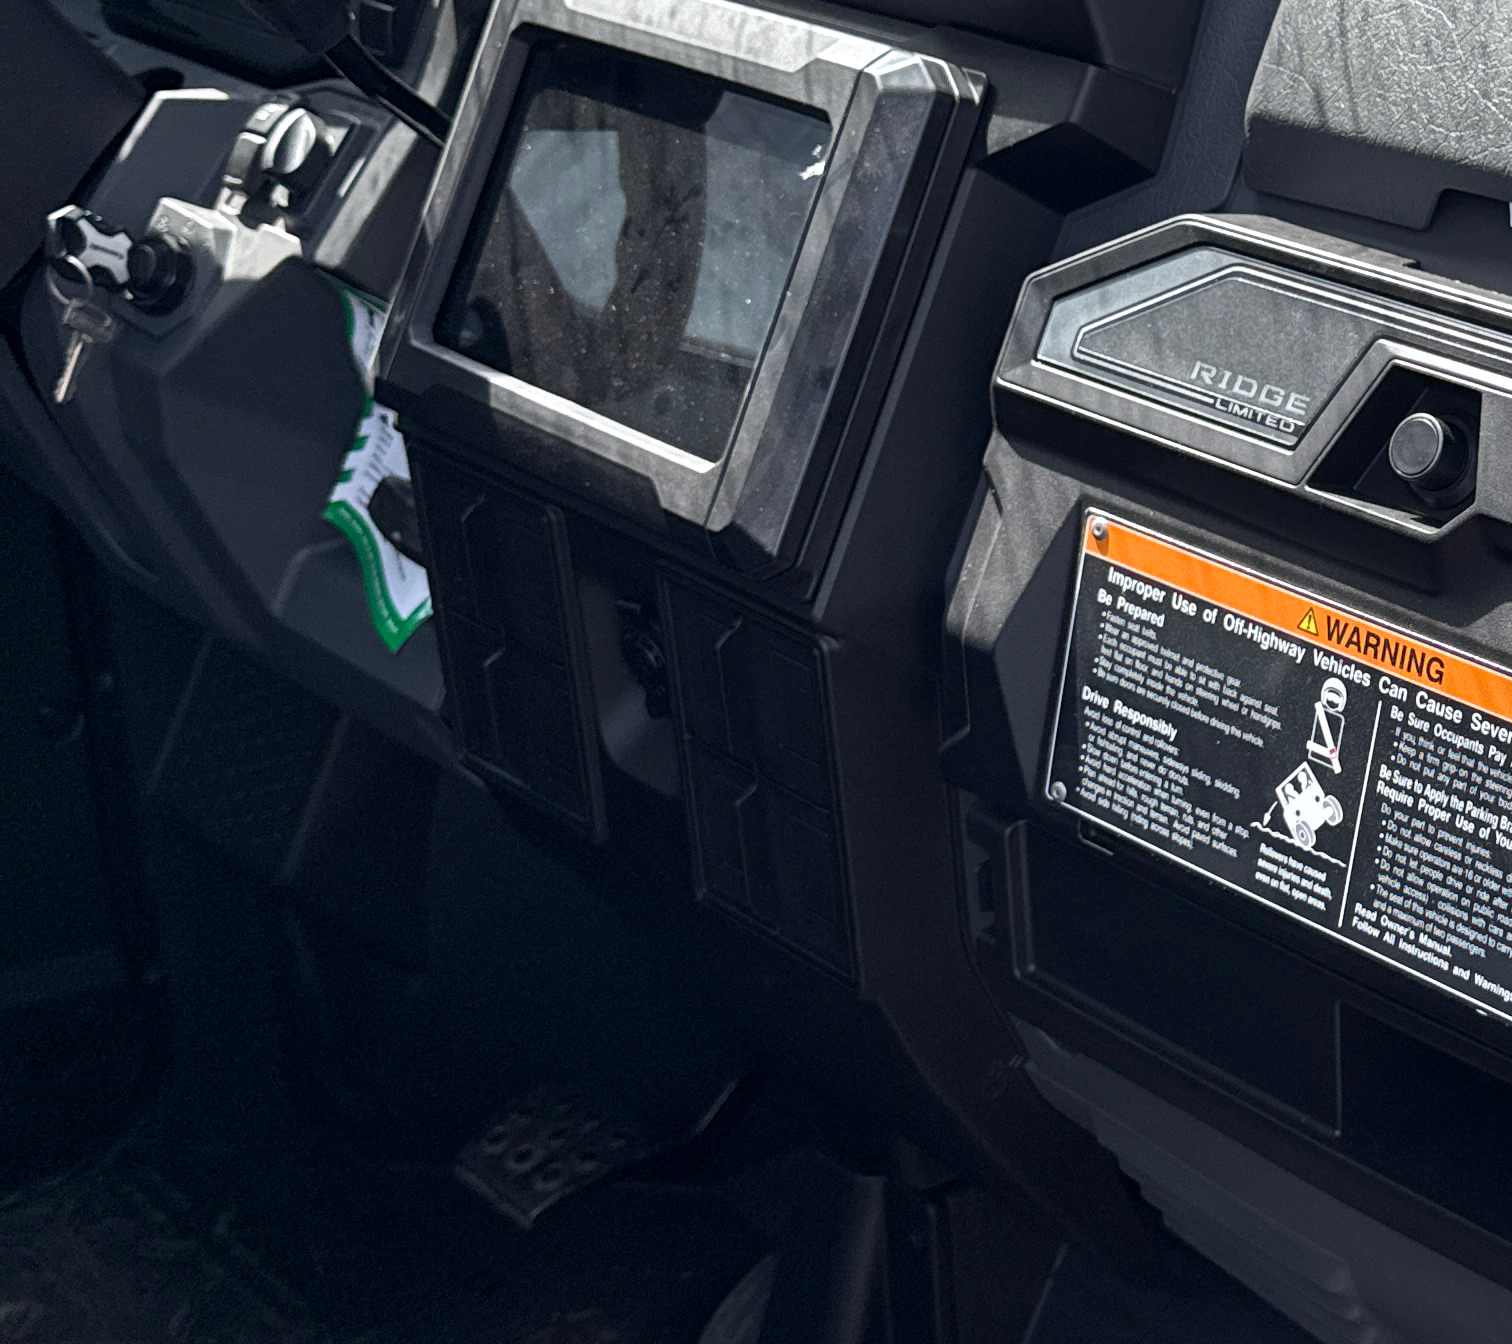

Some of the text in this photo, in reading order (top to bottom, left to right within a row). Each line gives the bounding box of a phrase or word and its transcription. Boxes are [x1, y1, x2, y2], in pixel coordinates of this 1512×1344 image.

[1190, 360, 1310, 415] RIDGE
[1215, 396, 1296, 433] LIMITED
[1097, 588, 1165, 627] Be Prepared
[1107, 567, 1165, 602] Improper
[1171, 592, 1197, 616] Use
[1202, 608, 1218, 625] of
[1223, 614, 1306, 663] Off-Highway
[1313, 649, 1371, 687] Vehicles
[1378, 676, 1408, 702] Can
[1415, 691, 1463, 724] Cause
[1326, 615, 1446, 686] WARNING
[1081, 685, 1177, 741] Drive Responsibly
[1390, 704, 1404, 722] Be
[1407, 712, 1430, 733] Sure
[1433, 723, 1484, 755] Occupants
[1488, 745, 1507, 767] Pay
[1376, 780, 1414, 807] Require
[1417, 798, 1451, 823] Proper
[1455, 814, 1475, 834] Use
[1478, 826, 1491, 840] of
[1379, 763, 1392, 781] Be
[1392, 769, 1413, 790] Sure
[1413, 779, 1424, 794] to
[1422, 784, 1450, 808] Apply
[1449, 794, 1465, 812] the
[1464, 800, 1499, 830] Parking
[1351, 916, 1381, 938] Follow
[1382, 931, 1396, 946] All
[1398, 938, 1449, 971] Instructions
[1452, 965, 1471, 981] and
[1354, 902, 1452, 957] Read Owner's Manual.
